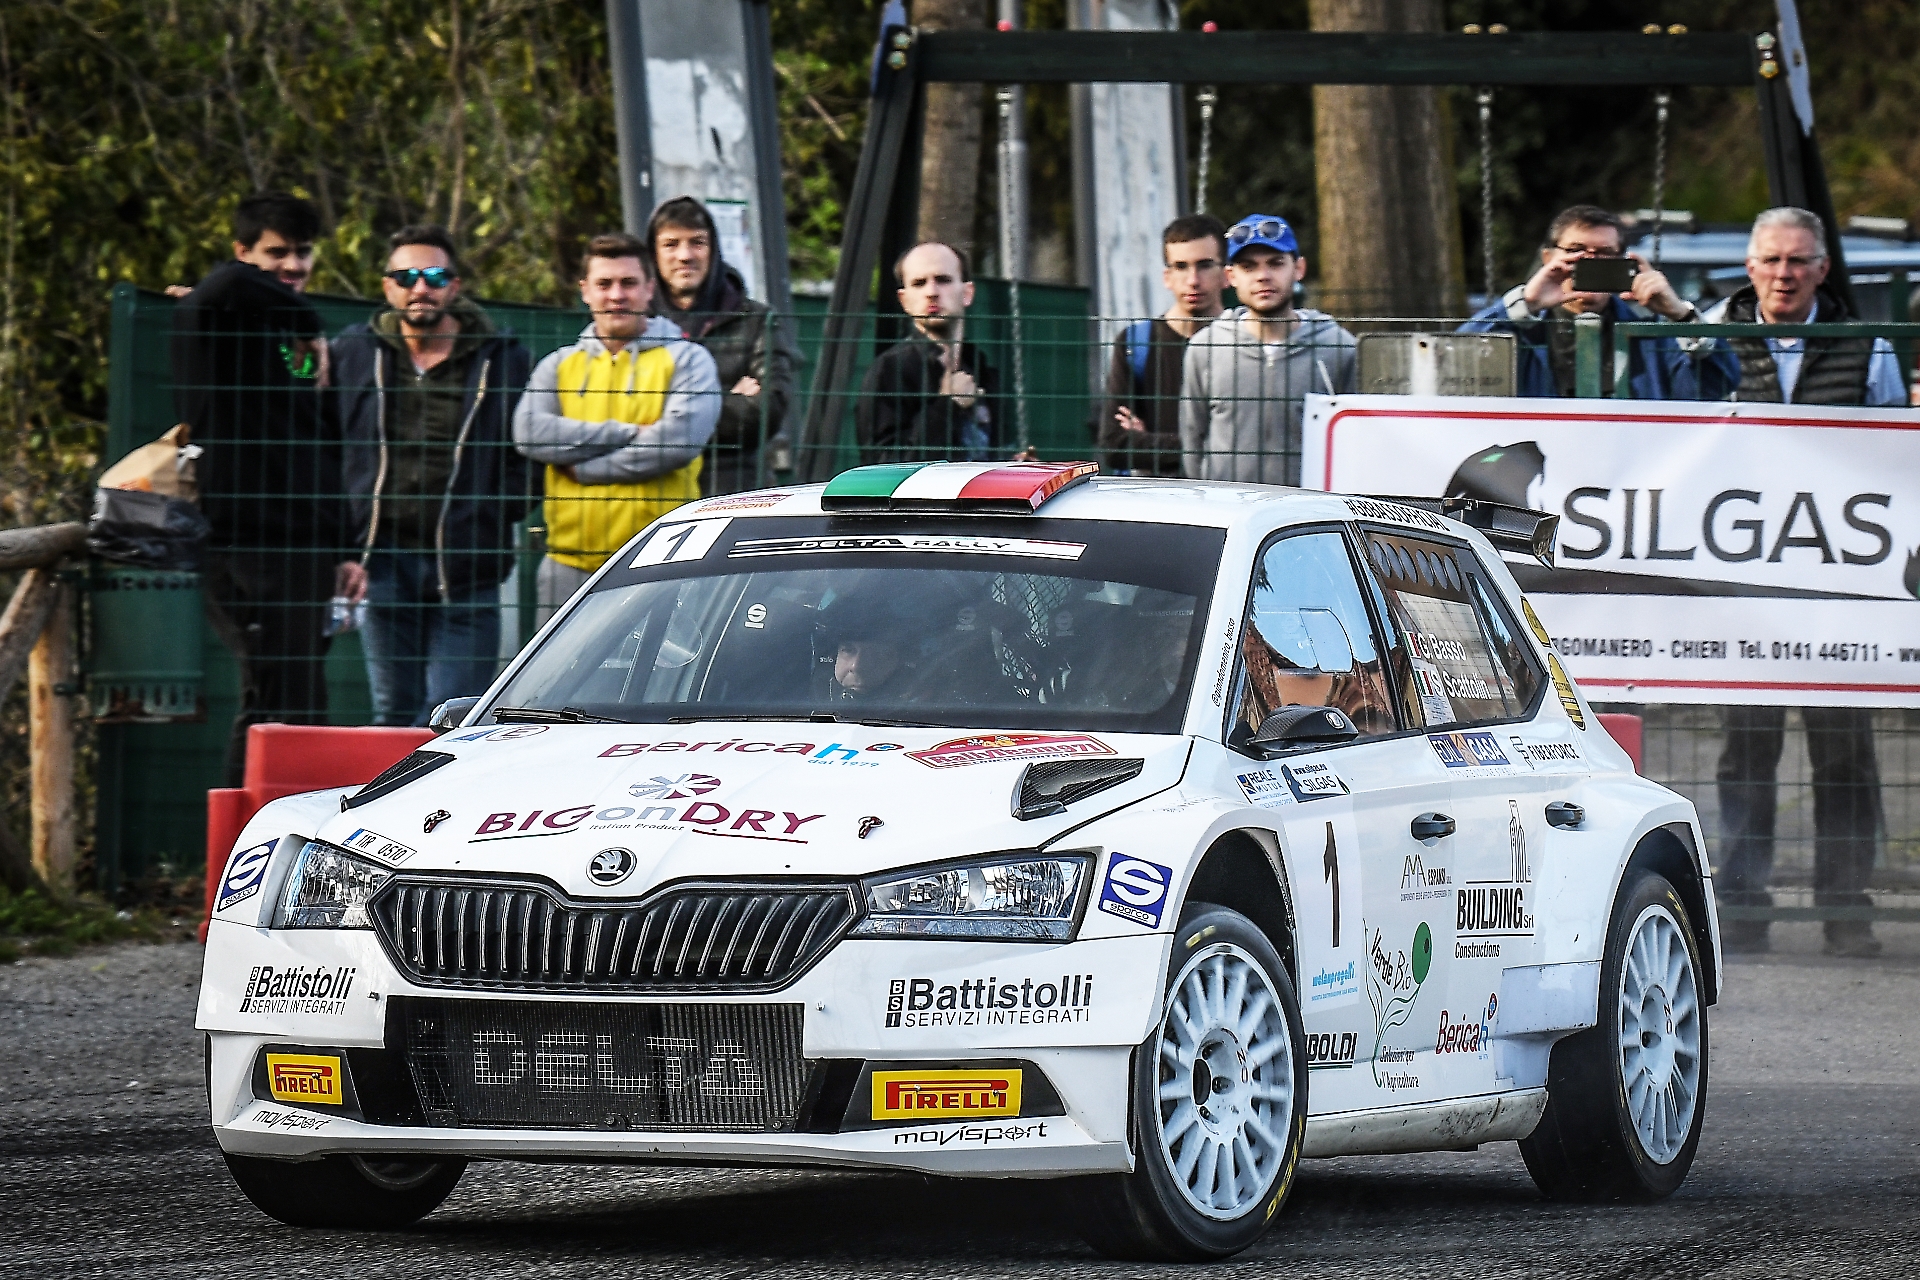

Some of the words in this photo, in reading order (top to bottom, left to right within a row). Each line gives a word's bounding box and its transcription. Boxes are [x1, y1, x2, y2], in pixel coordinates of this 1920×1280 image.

[1562, 487, 1893, 566] SILGAS
[662, 525, 698, 561] 1
[800, 539, 899, 549] DELTA
[912, 539, 1010, 549] RALLY
[1427, 633, 1467, 660] Basso
[1671, 639, 1728, 660] CHIERI
[1738, 640, 1766, 660] Tel.
[1771, 641, 1812, 661] 0141
[1442, 670, 1492, 700] Scattolin
[597, 738, 860, 760] Bericah
[1431, 739, 1463, 763] EDIL
[1466, 735, 1507, 762] CASA
[1527, 743, 1580, 761] FIBERFORCE
[1247, 769, 1277, 784] REALE
[1256, 781, 1284, 793] MUTUA
[1302, 775, 1337, 792] SILGAS
[634, 823, 685, 832] Product
[1323, 820, 1340, 948] 1
[1109, 902, 1149, 921] sparco
[1456, 887, 1524, 930] BUILDING
[1523, 915, 1534, 929] Srl
[1371, 926, 1394, 986] Verde
[1455, 941, 1501, 959] Constructions
[254, 965, 357, 999] Battistolli
[1393, 949, 1412, 993] Bio
[907, 974, 1093, 1011] Battistolli
[250, 999, 289, 1014] SERVIZI
[288, 999, 346, 1015] INTEGRATI
[905, 1011, 980, 1027] SERVIZI
[987, 1008, 1090, 1026] INTEGRATI
[1436, 1007, 1489, 1055] Bericah
[473, 1028, 765, 1096] DELTA
[273, 1063, 333, 1095] PIRELLI
[885, 1079, 1009, 1110] PIRELLI
[252, 1109, 332, 1131] movisport
[894, 1121, 1048, 1146] movisport
